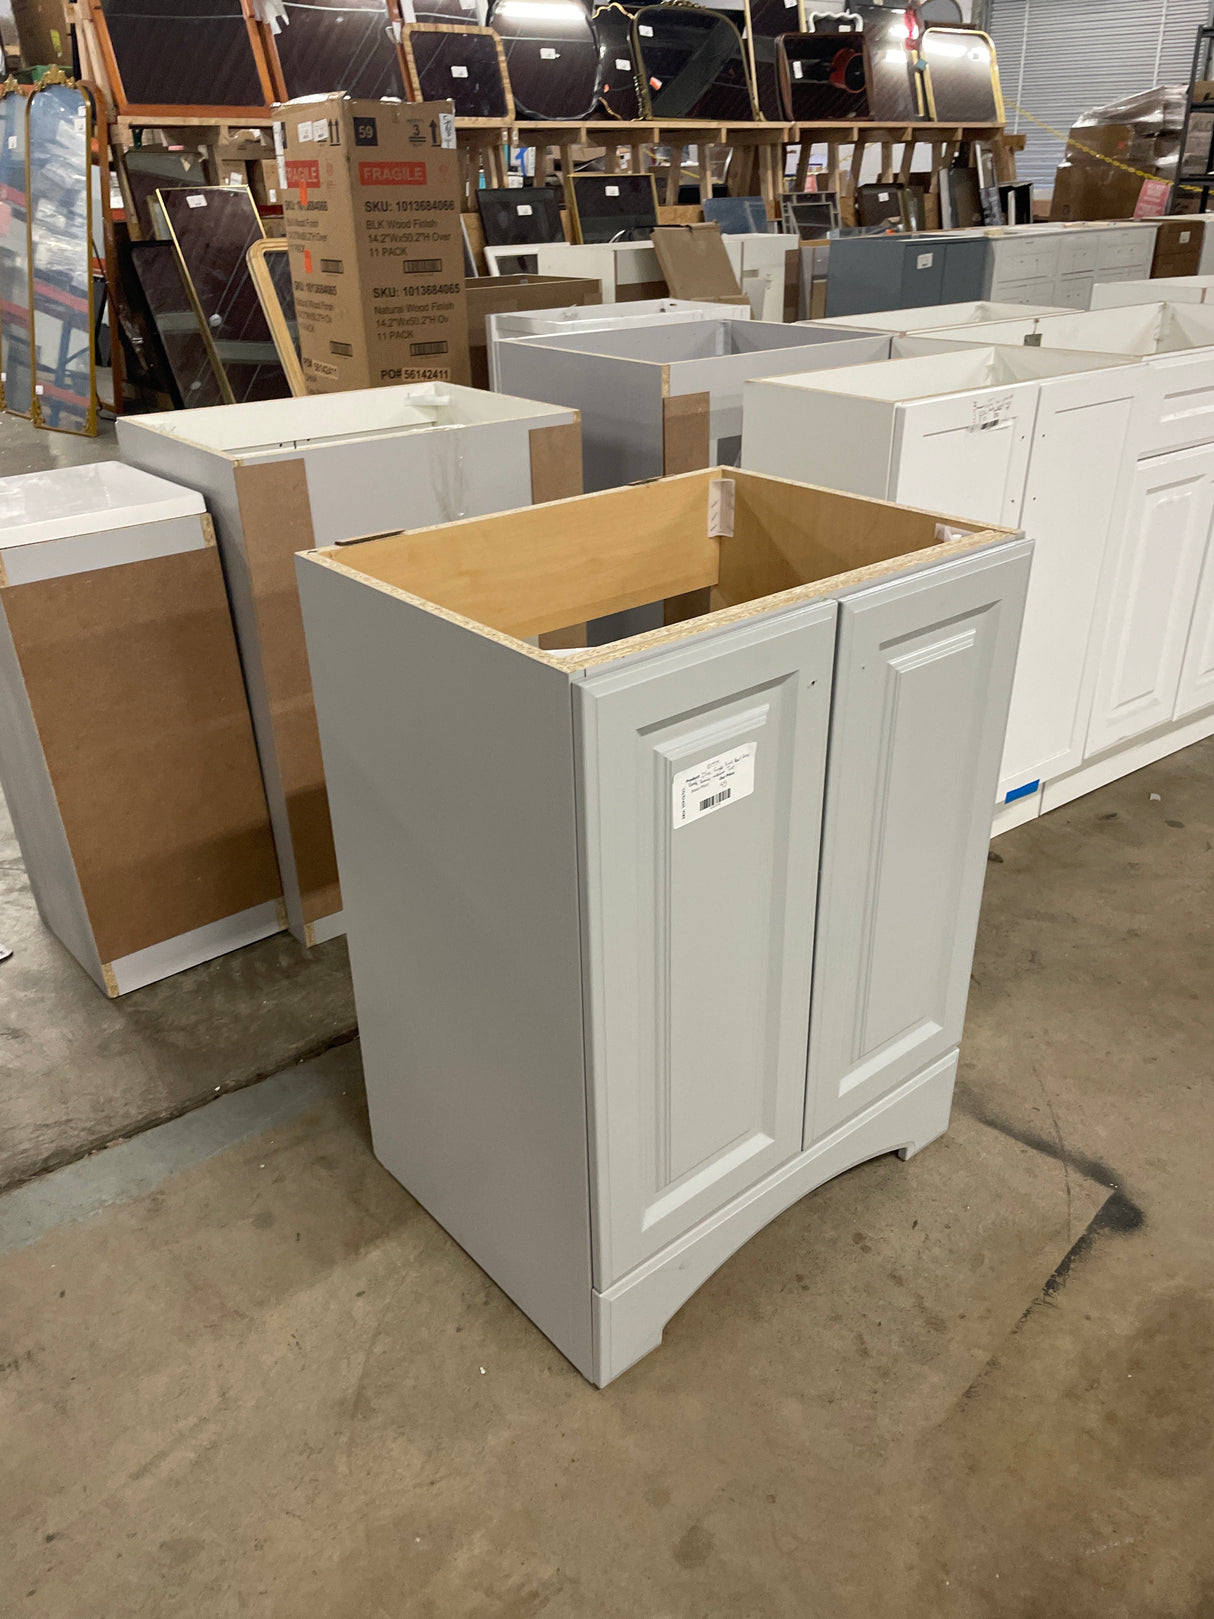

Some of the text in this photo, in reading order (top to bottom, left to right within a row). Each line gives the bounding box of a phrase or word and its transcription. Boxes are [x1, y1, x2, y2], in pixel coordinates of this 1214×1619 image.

[359, 125, 373, 138] 59
[413, 124, 421, 137] 3
[363, 167, 424, 181] FRAGILE
[365, 200, 455, 213] SKU: 1013684066
[366, 218, 438, 230] BLK Wood Finish
[432, 231, 451, 242] Over
[369, 246, 408, 257] 11 PACK
[373, 283, 460, 299] SKU: 1013684065
[374, 301, 455, 315] Natural Wood Finish
[377, 329, 415, 341] 11 PACK
[381, 367, 449, 380] PO# 56142411
